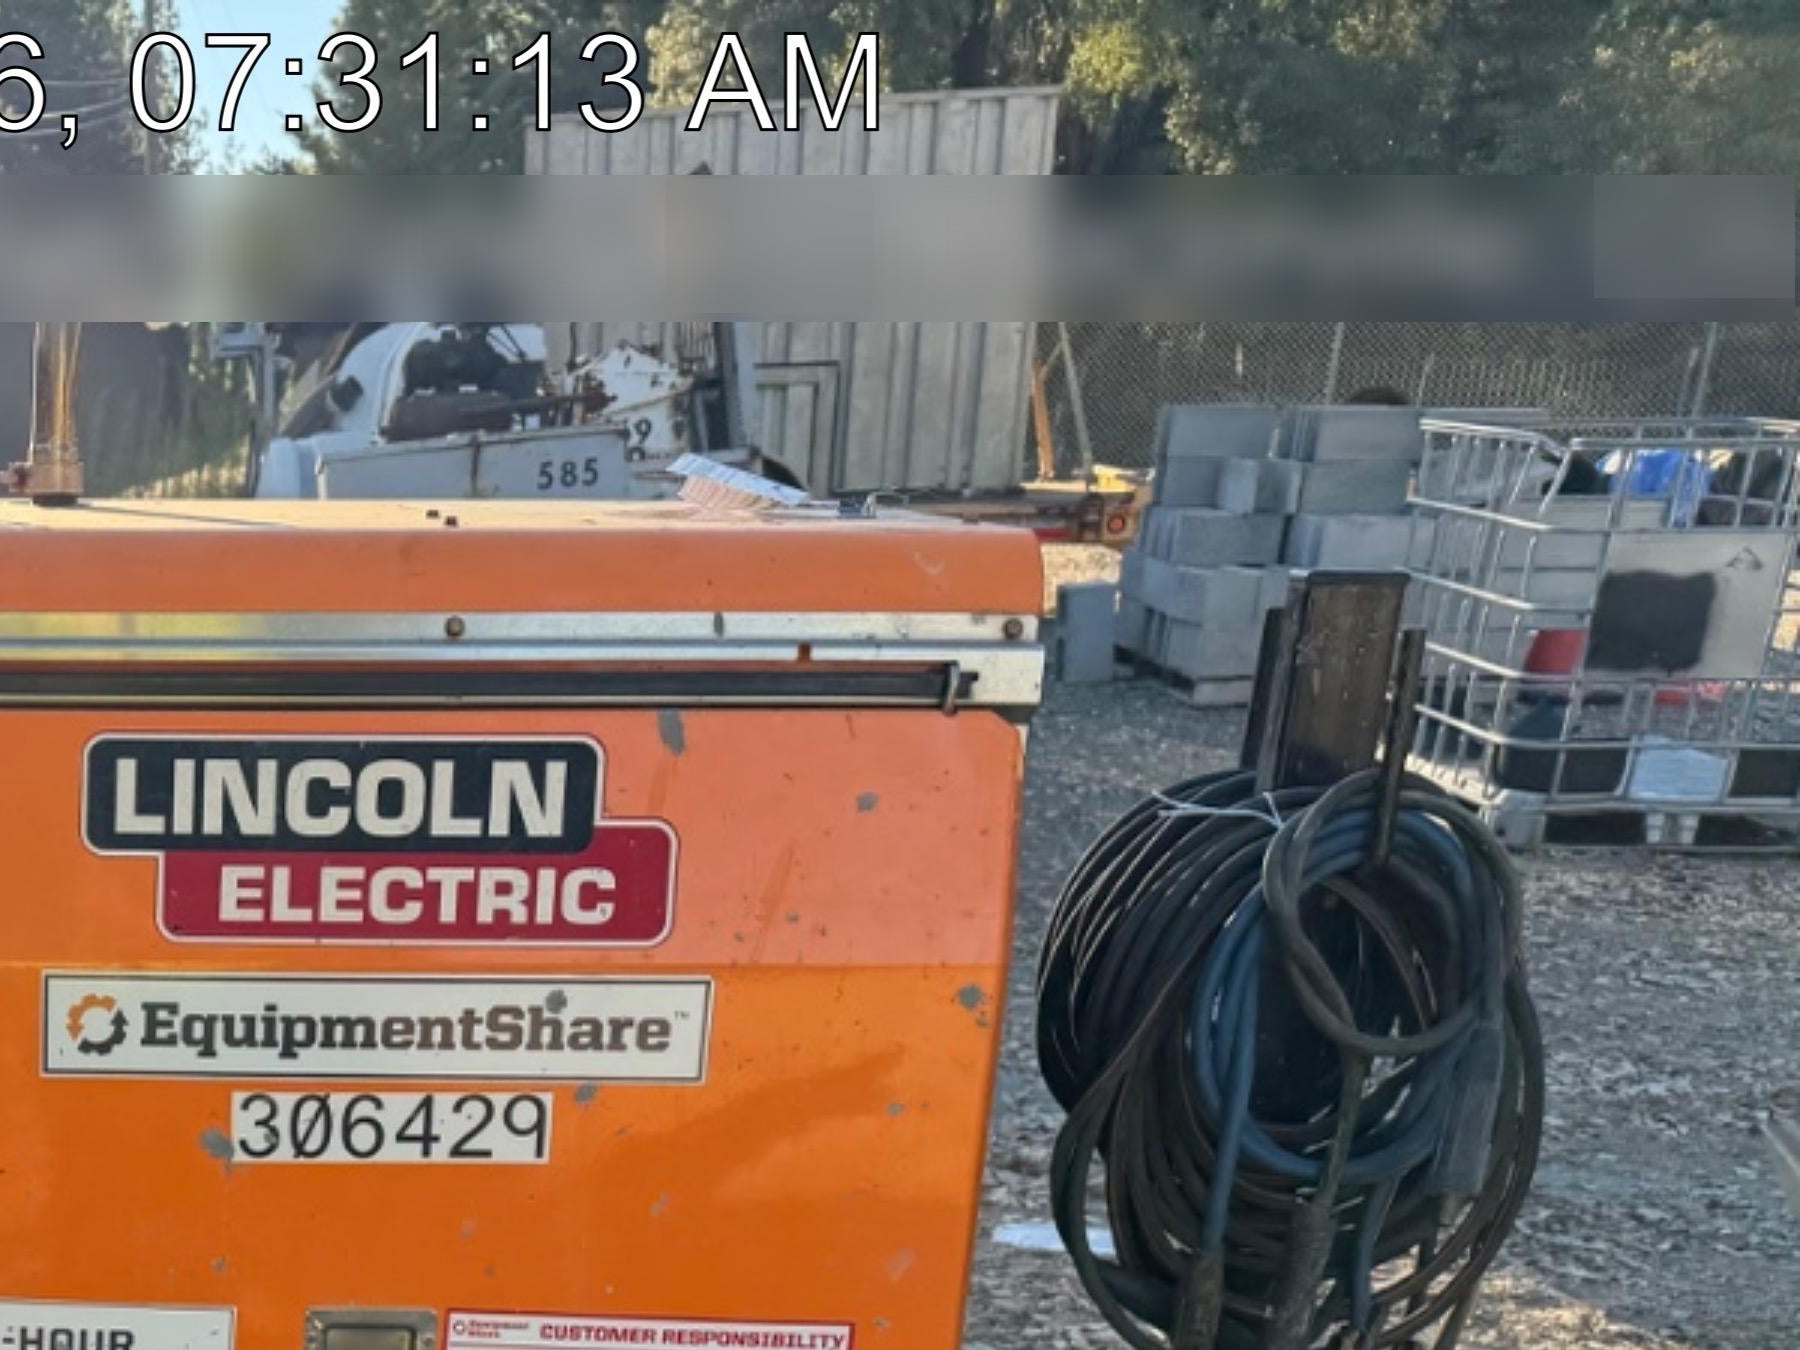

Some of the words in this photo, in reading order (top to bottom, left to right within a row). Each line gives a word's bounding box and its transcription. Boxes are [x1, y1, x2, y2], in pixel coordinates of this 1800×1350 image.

[537, 456, 599, 490] 585
[112, 756, 569, 839] LINCOLN
[218, 864, 617, 927] ELECTRIC
[140, 1000, 673, 1060] EquipmentShare
[236, 1092, 550, 1160] 306429
[539, 1322, 657, 1344] CUSTOMER
[661, 1327, 845, 1350] RESPONSIBILITY
